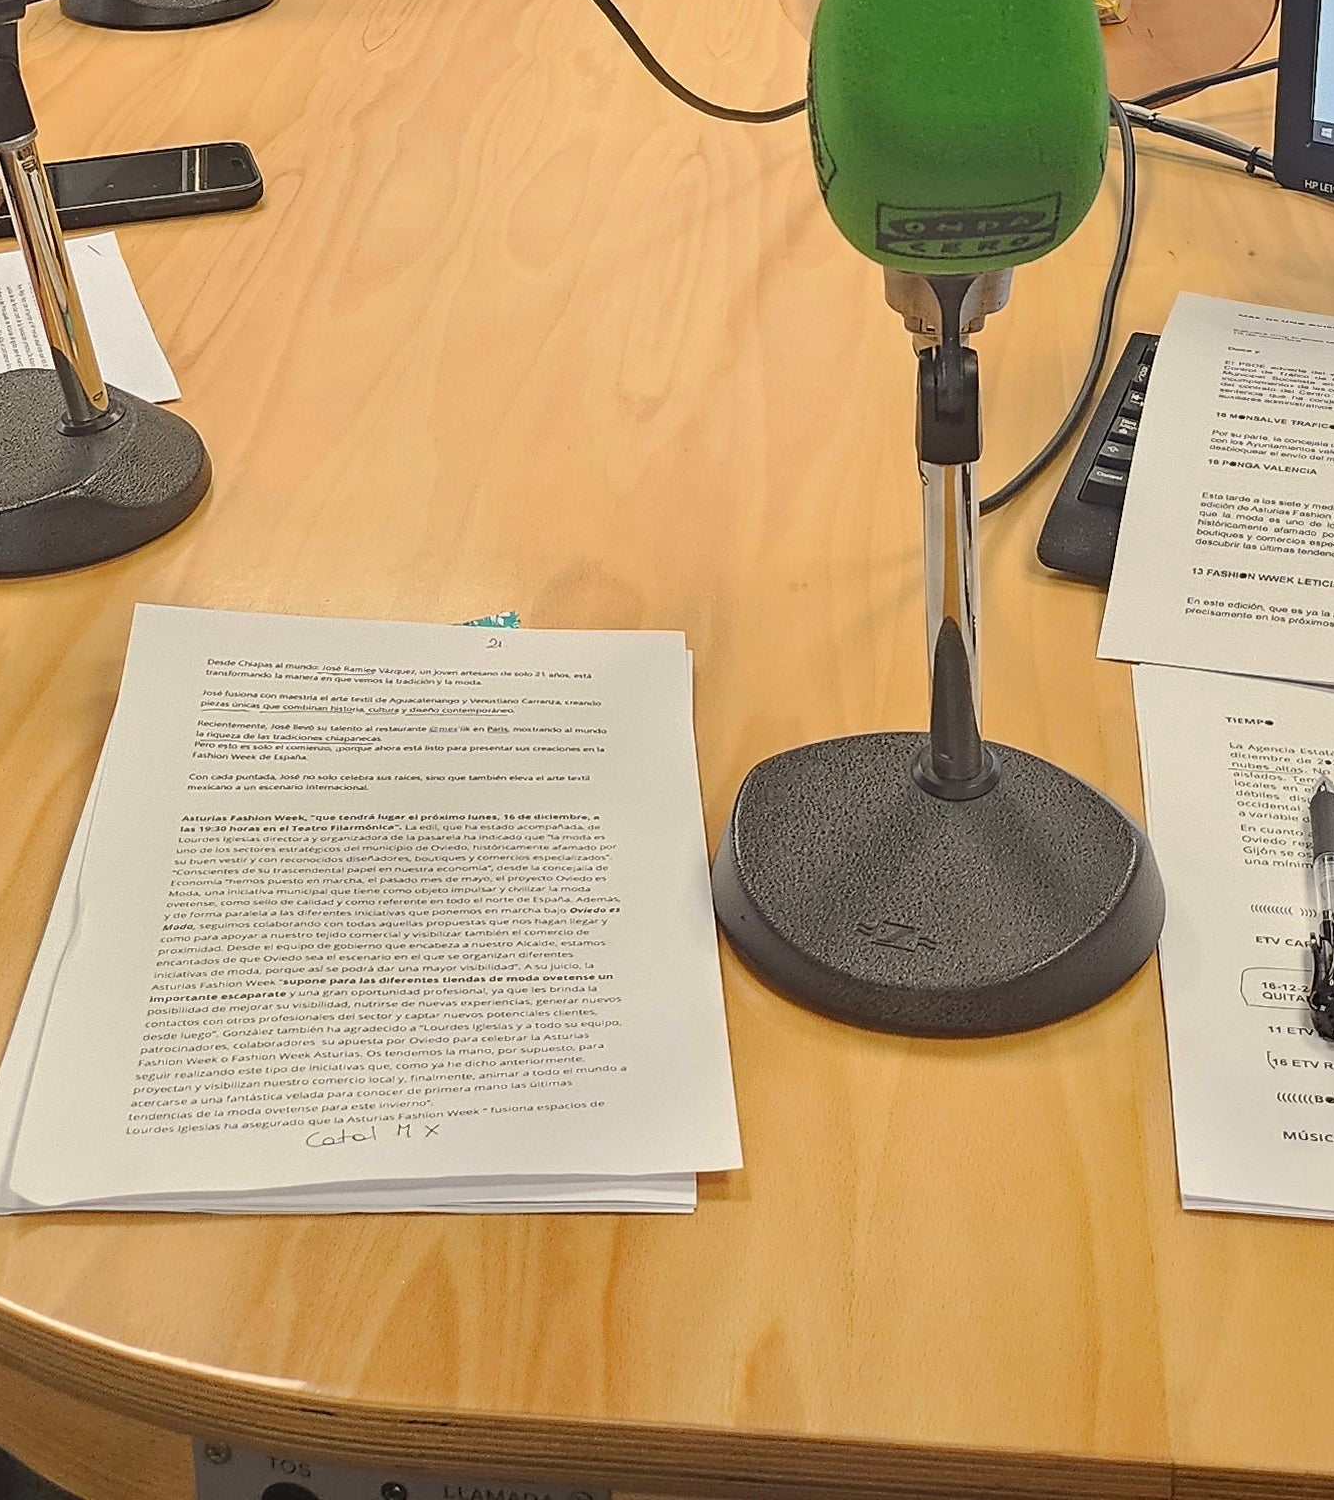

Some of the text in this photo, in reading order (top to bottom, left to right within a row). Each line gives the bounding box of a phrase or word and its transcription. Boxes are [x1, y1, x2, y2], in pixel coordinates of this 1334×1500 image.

[1304, 179, 1318, 190] HP
[904, 216, 1030, 233] ONDA
[910, 237, 1030, 253] CERO
[1206, 568, 1256, 581] FASHION
[1258, 573, 1294, 585] WWEK
[1186, 596, 1201, 605] En
[1203, 599, 1225, 608] esta
[1227, 602, 1266, 612] edición,
[1268, 605, 1289, 613] que
[1305, 609, 1319, 617] ya
[1321, 609, 1331, 618] la
[230, 814, 272, 822] Fashion
[274, 814, 308, 822] Week,
[310, 814, 336, 822] "que
[338, 813, 376, 821] tendrá
[377, 813, 406, 822] lugar
[420, 814, 466, 822] próximo
[199, 825, 227, 833] 19:30
[330, 823, 402, 832] Filarmónica".
[1255, 935, 1281, 946] ETV
[149, 991, 287, 1005] importante escaparate
[1271, 1058, 1288, 1068] 16
[1291, 1059, 1320, 1069] ETV
[268, 1456, 312, 1477] TOS
